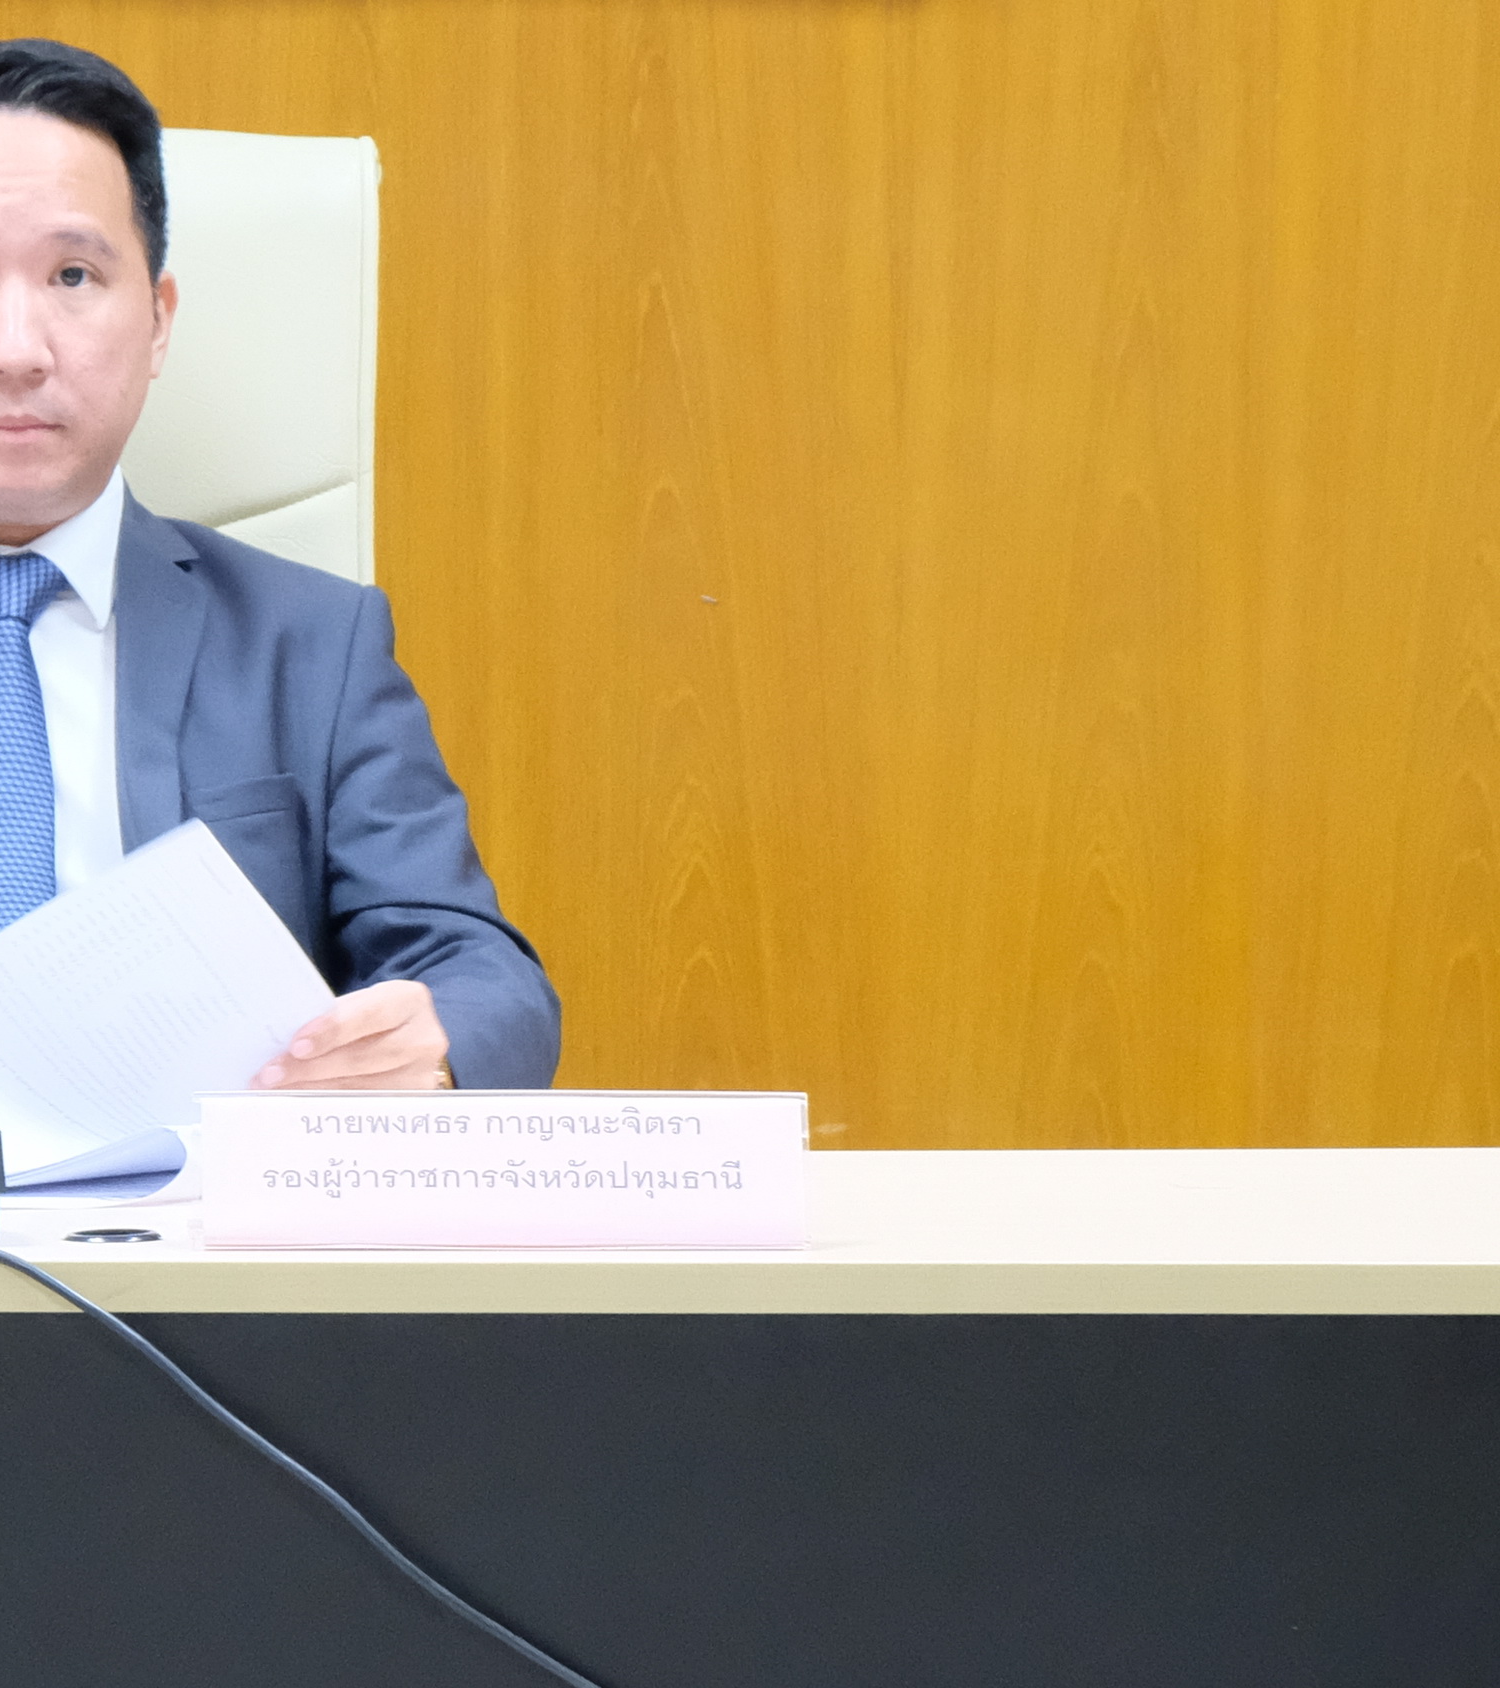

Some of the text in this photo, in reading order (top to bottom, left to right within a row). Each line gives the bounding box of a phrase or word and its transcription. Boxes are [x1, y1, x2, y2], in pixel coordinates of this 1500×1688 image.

[300, 1105, 702, 1142] นายพงศธร กาญจนะจิตรา
[262, 1158, 744, 1200] รองผู้ว่าราชการจังหวัดปทุมธานี
